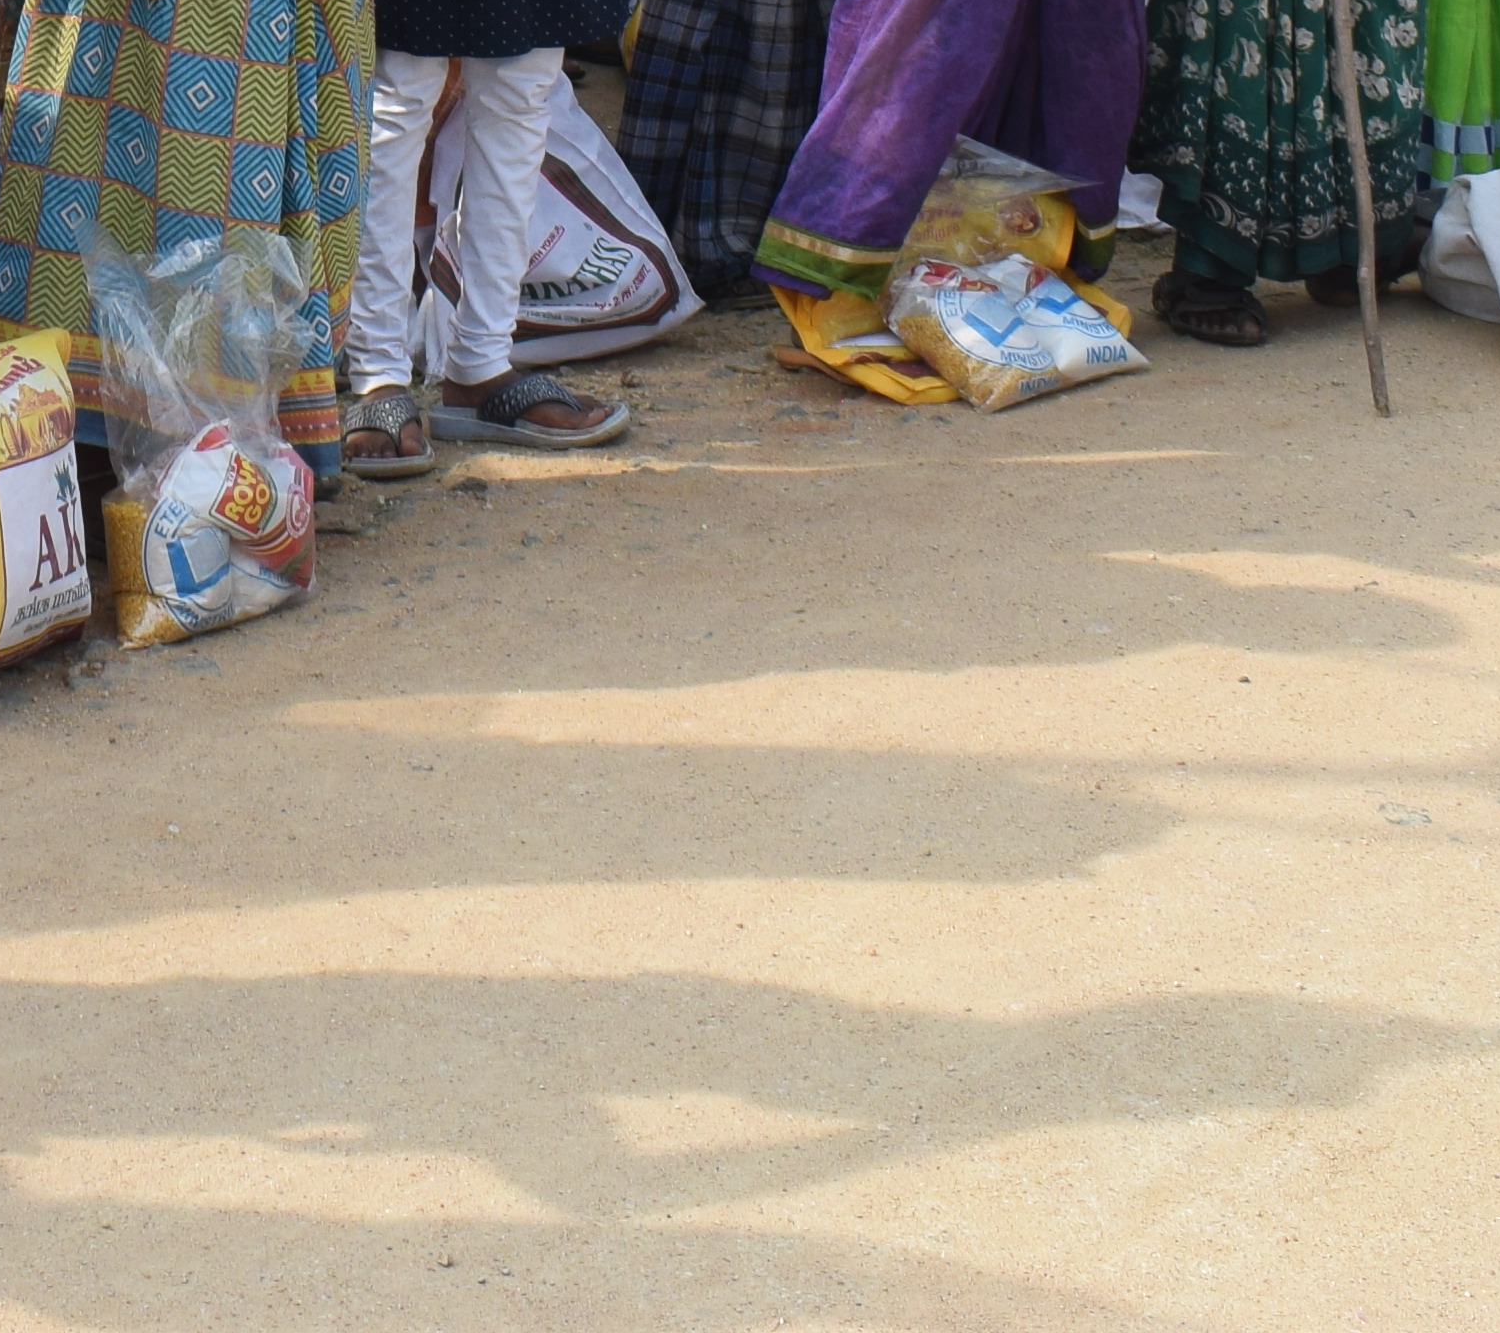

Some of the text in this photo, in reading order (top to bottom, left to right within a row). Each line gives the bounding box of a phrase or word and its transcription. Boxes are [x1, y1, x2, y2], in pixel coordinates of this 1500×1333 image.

[1063, 316, 1116, 334] MINISTR
[1000, 348, 1049, 367] MINISTR
[1086, 344, 1128, 364] INDIA
[244, 481, 270, 525] GO
[29, 497, 85, 592] AK
